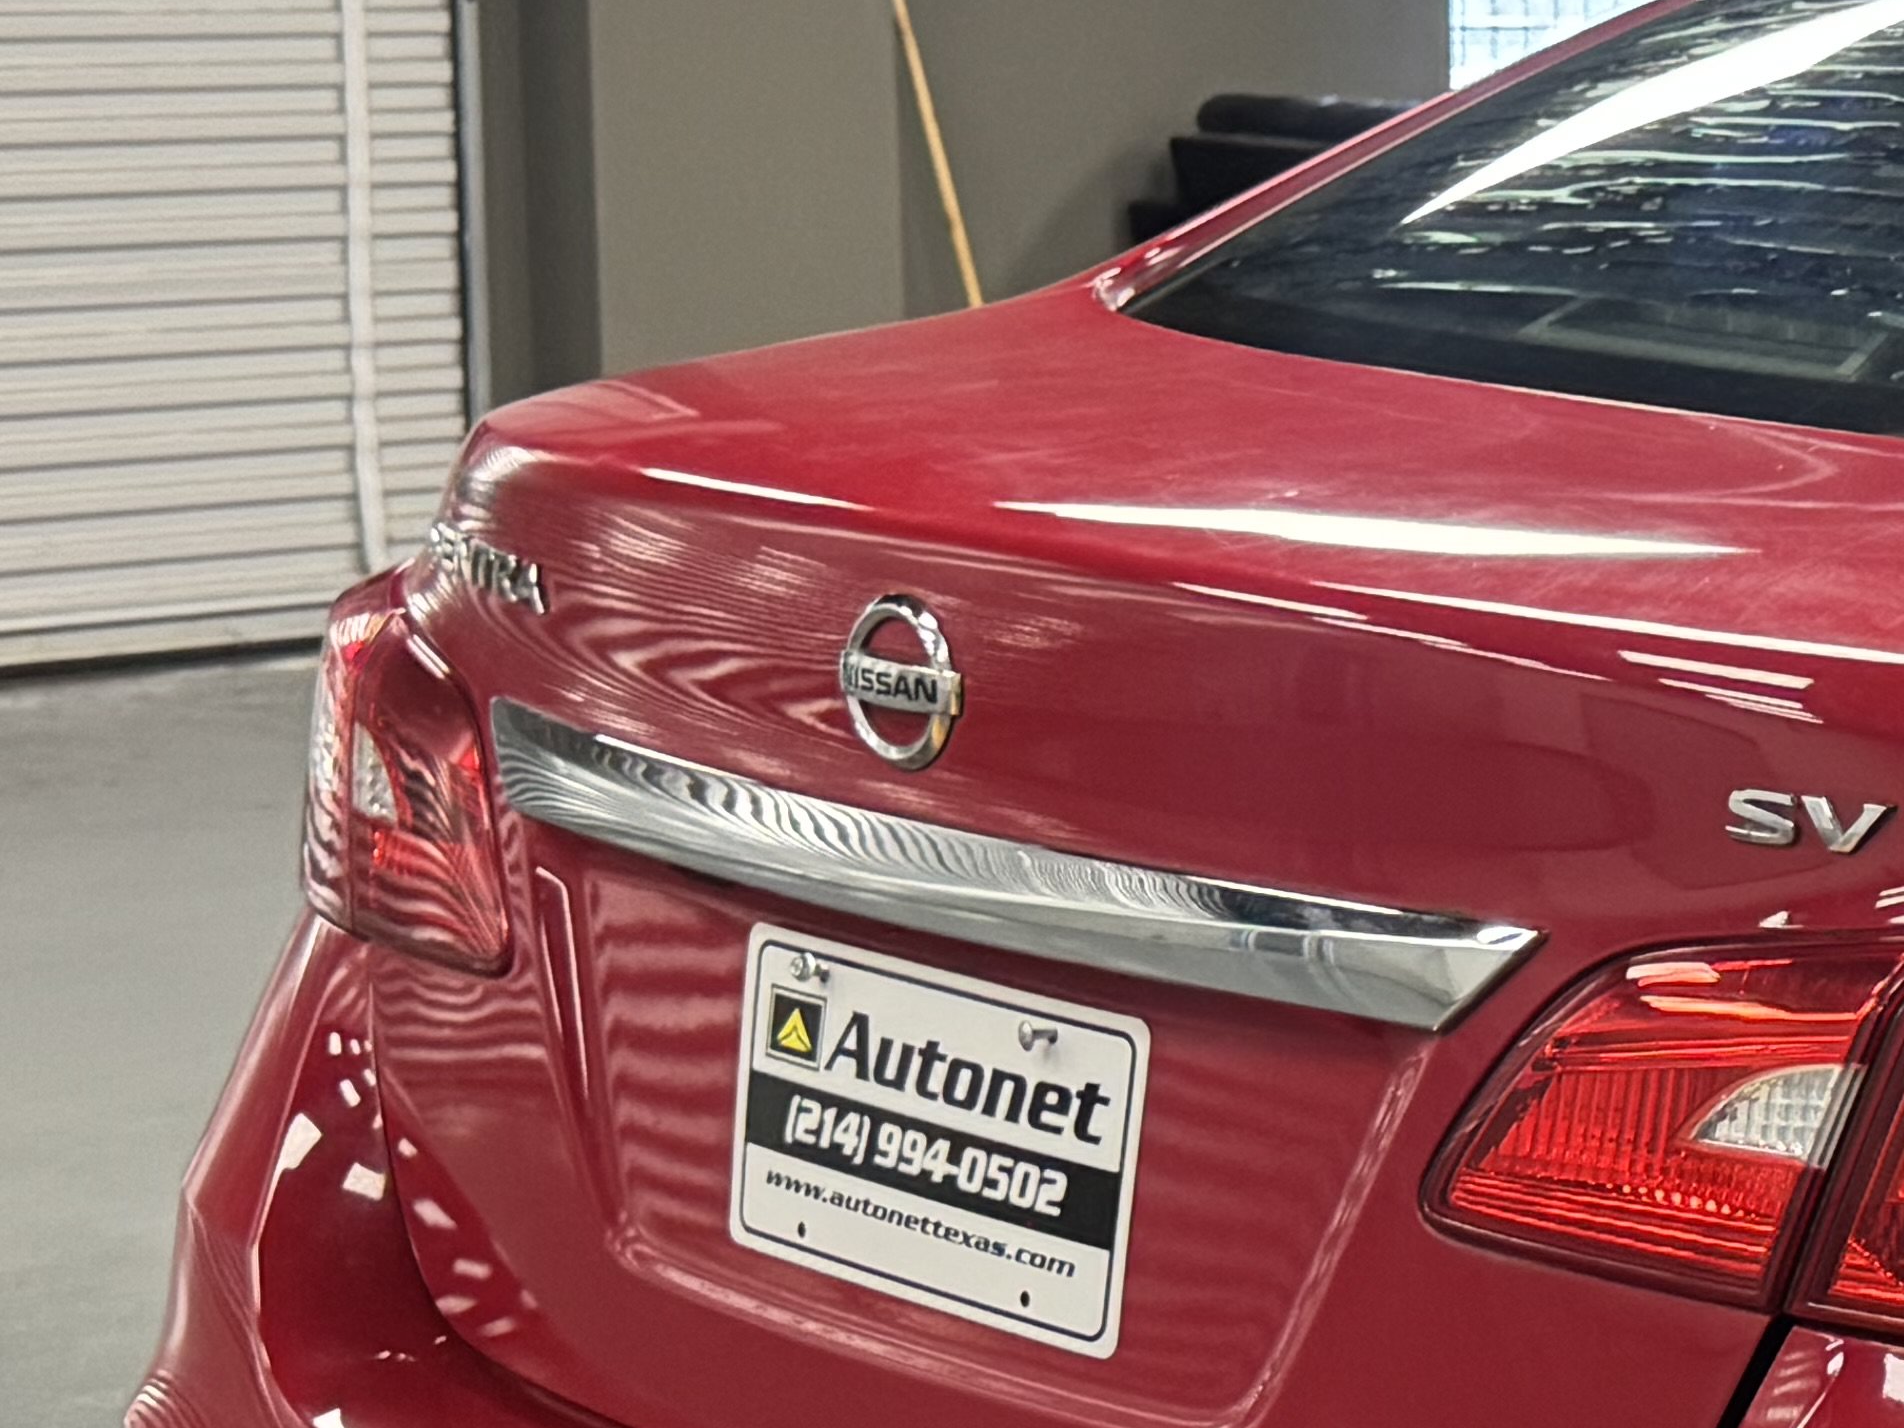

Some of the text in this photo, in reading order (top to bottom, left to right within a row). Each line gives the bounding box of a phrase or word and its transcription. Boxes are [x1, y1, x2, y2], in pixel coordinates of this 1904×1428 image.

[1725, 788, 1897, 853] SV
[825, 1011, 1111, 1145] Autonet
[785, 1094, 1068, 1217] (214) 994-0502
[766, 1169, 1075, 1278] www.autonettexas.com
